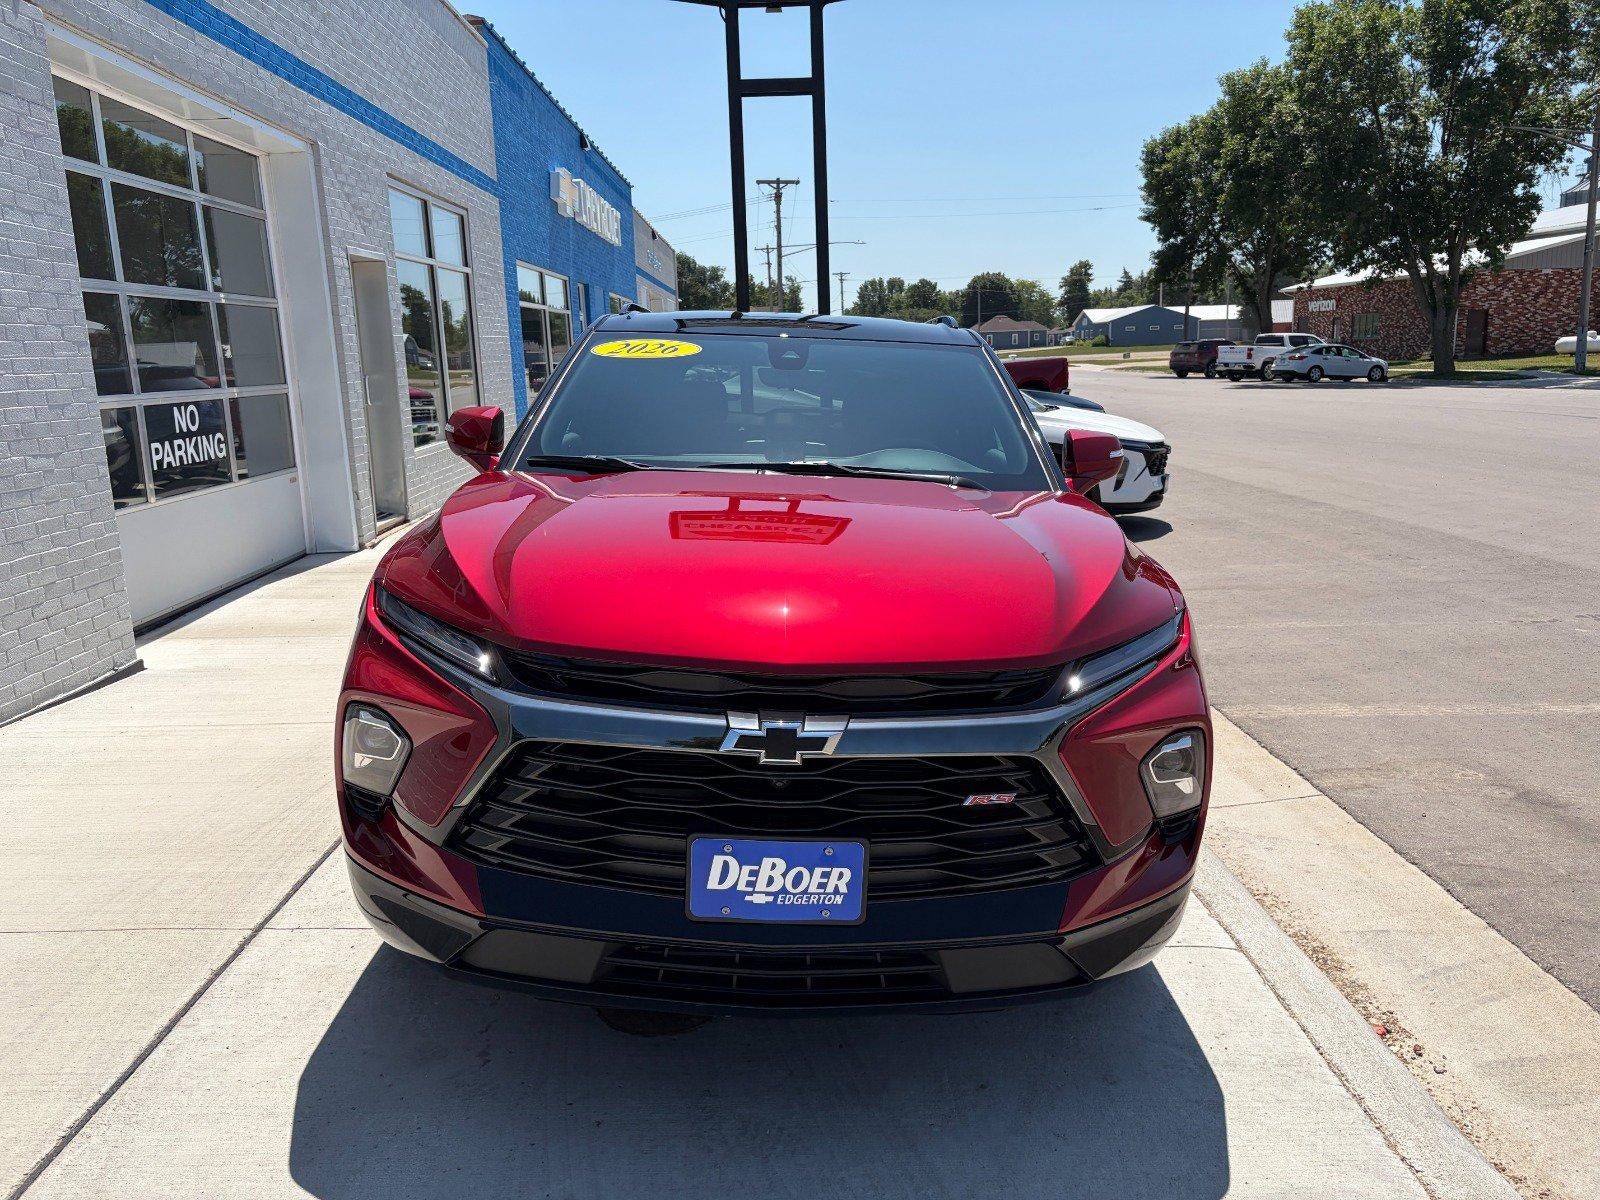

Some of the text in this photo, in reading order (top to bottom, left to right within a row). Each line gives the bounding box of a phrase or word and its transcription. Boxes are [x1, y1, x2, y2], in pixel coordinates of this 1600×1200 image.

[1308, 297, 1337, 312] verizon
[606, 342, 679, 355] 2026
[173, 404, 200, 434] NO
[150, 432, 227, 471] PARKING
[962, 792, 1017, 806] RS
[776, 893, 844, 905] EDGERTON
